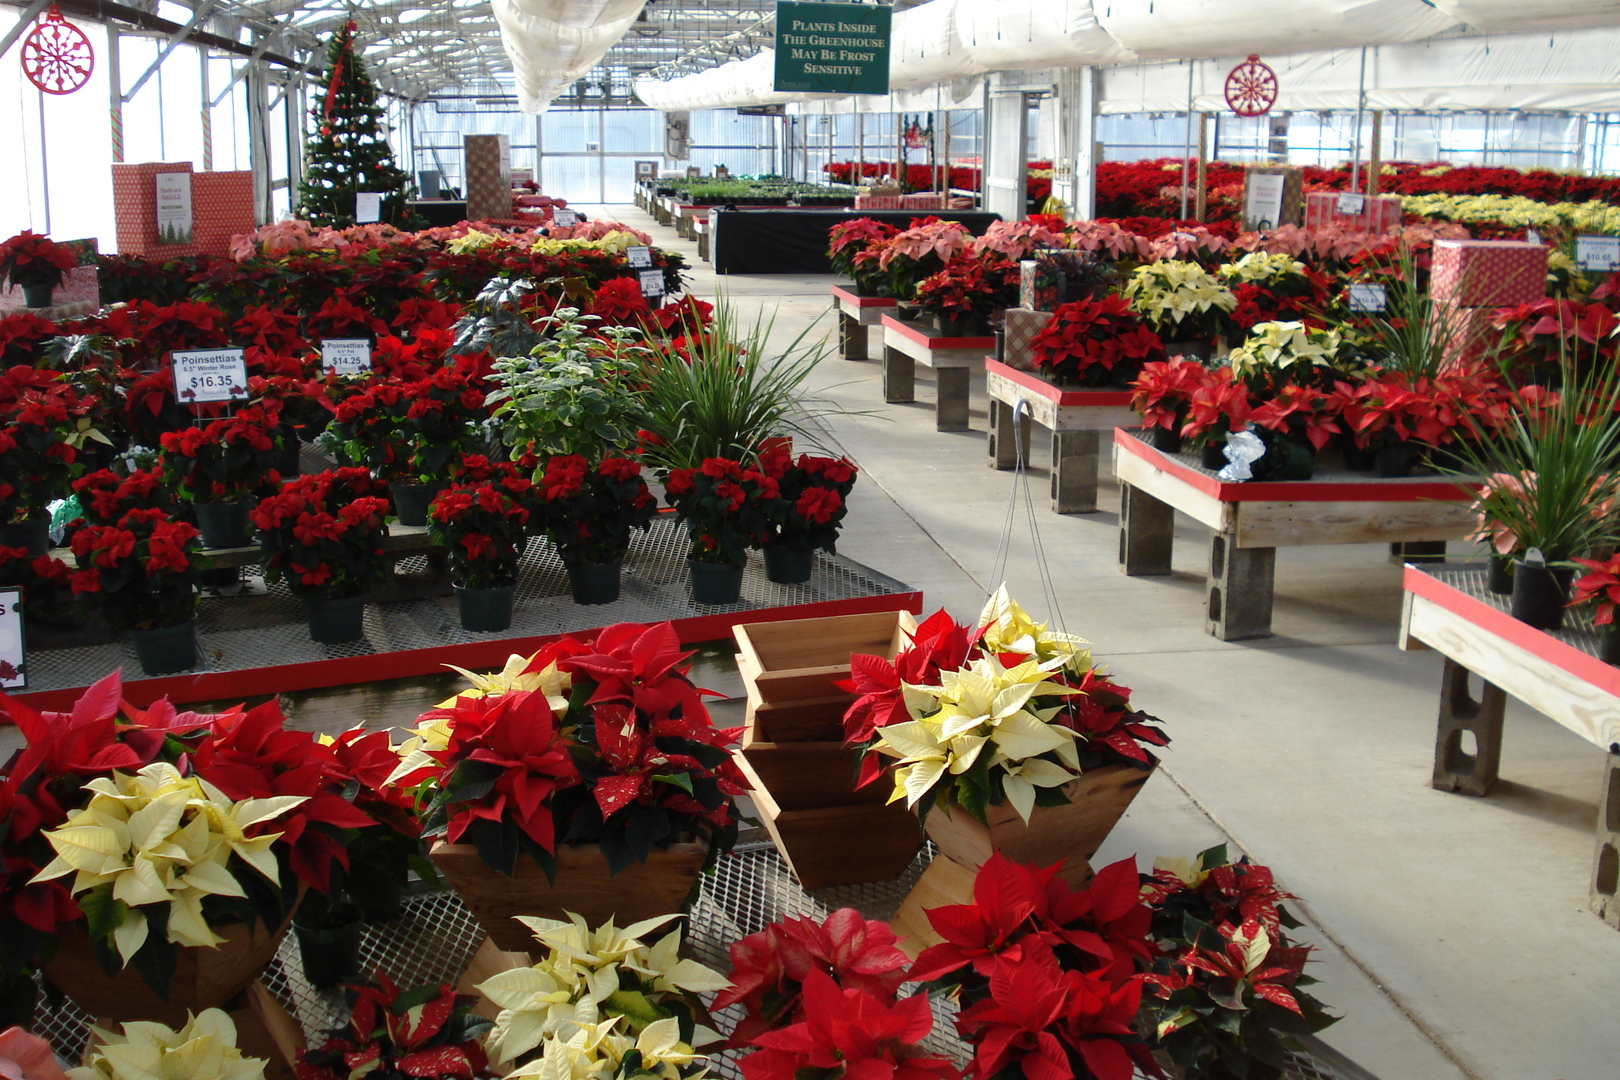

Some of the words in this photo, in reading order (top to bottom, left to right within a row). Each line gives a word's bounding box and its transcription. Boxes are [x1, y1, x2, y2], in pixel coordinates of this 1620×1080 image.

[792, 20, 835, 32] PLANTS
[838, 21, 876, 33] INSIDE
[782, 34, 806, 45] THE
[808, 35, 885, 48] GREENHOUSE
[791, 48, 818, 60] MAY
[821, 49, 837, 60] BE
[839, 50, 876, 61] FROST
[804, 62, 862, 75] SENSITIVE
[1586, 253, 1612, 261] $10.65
[182, 355, 236, 365] Poinsettias
[332, 357, 361, 365] $14.25
[190, 375, 233, 388] $16.35
